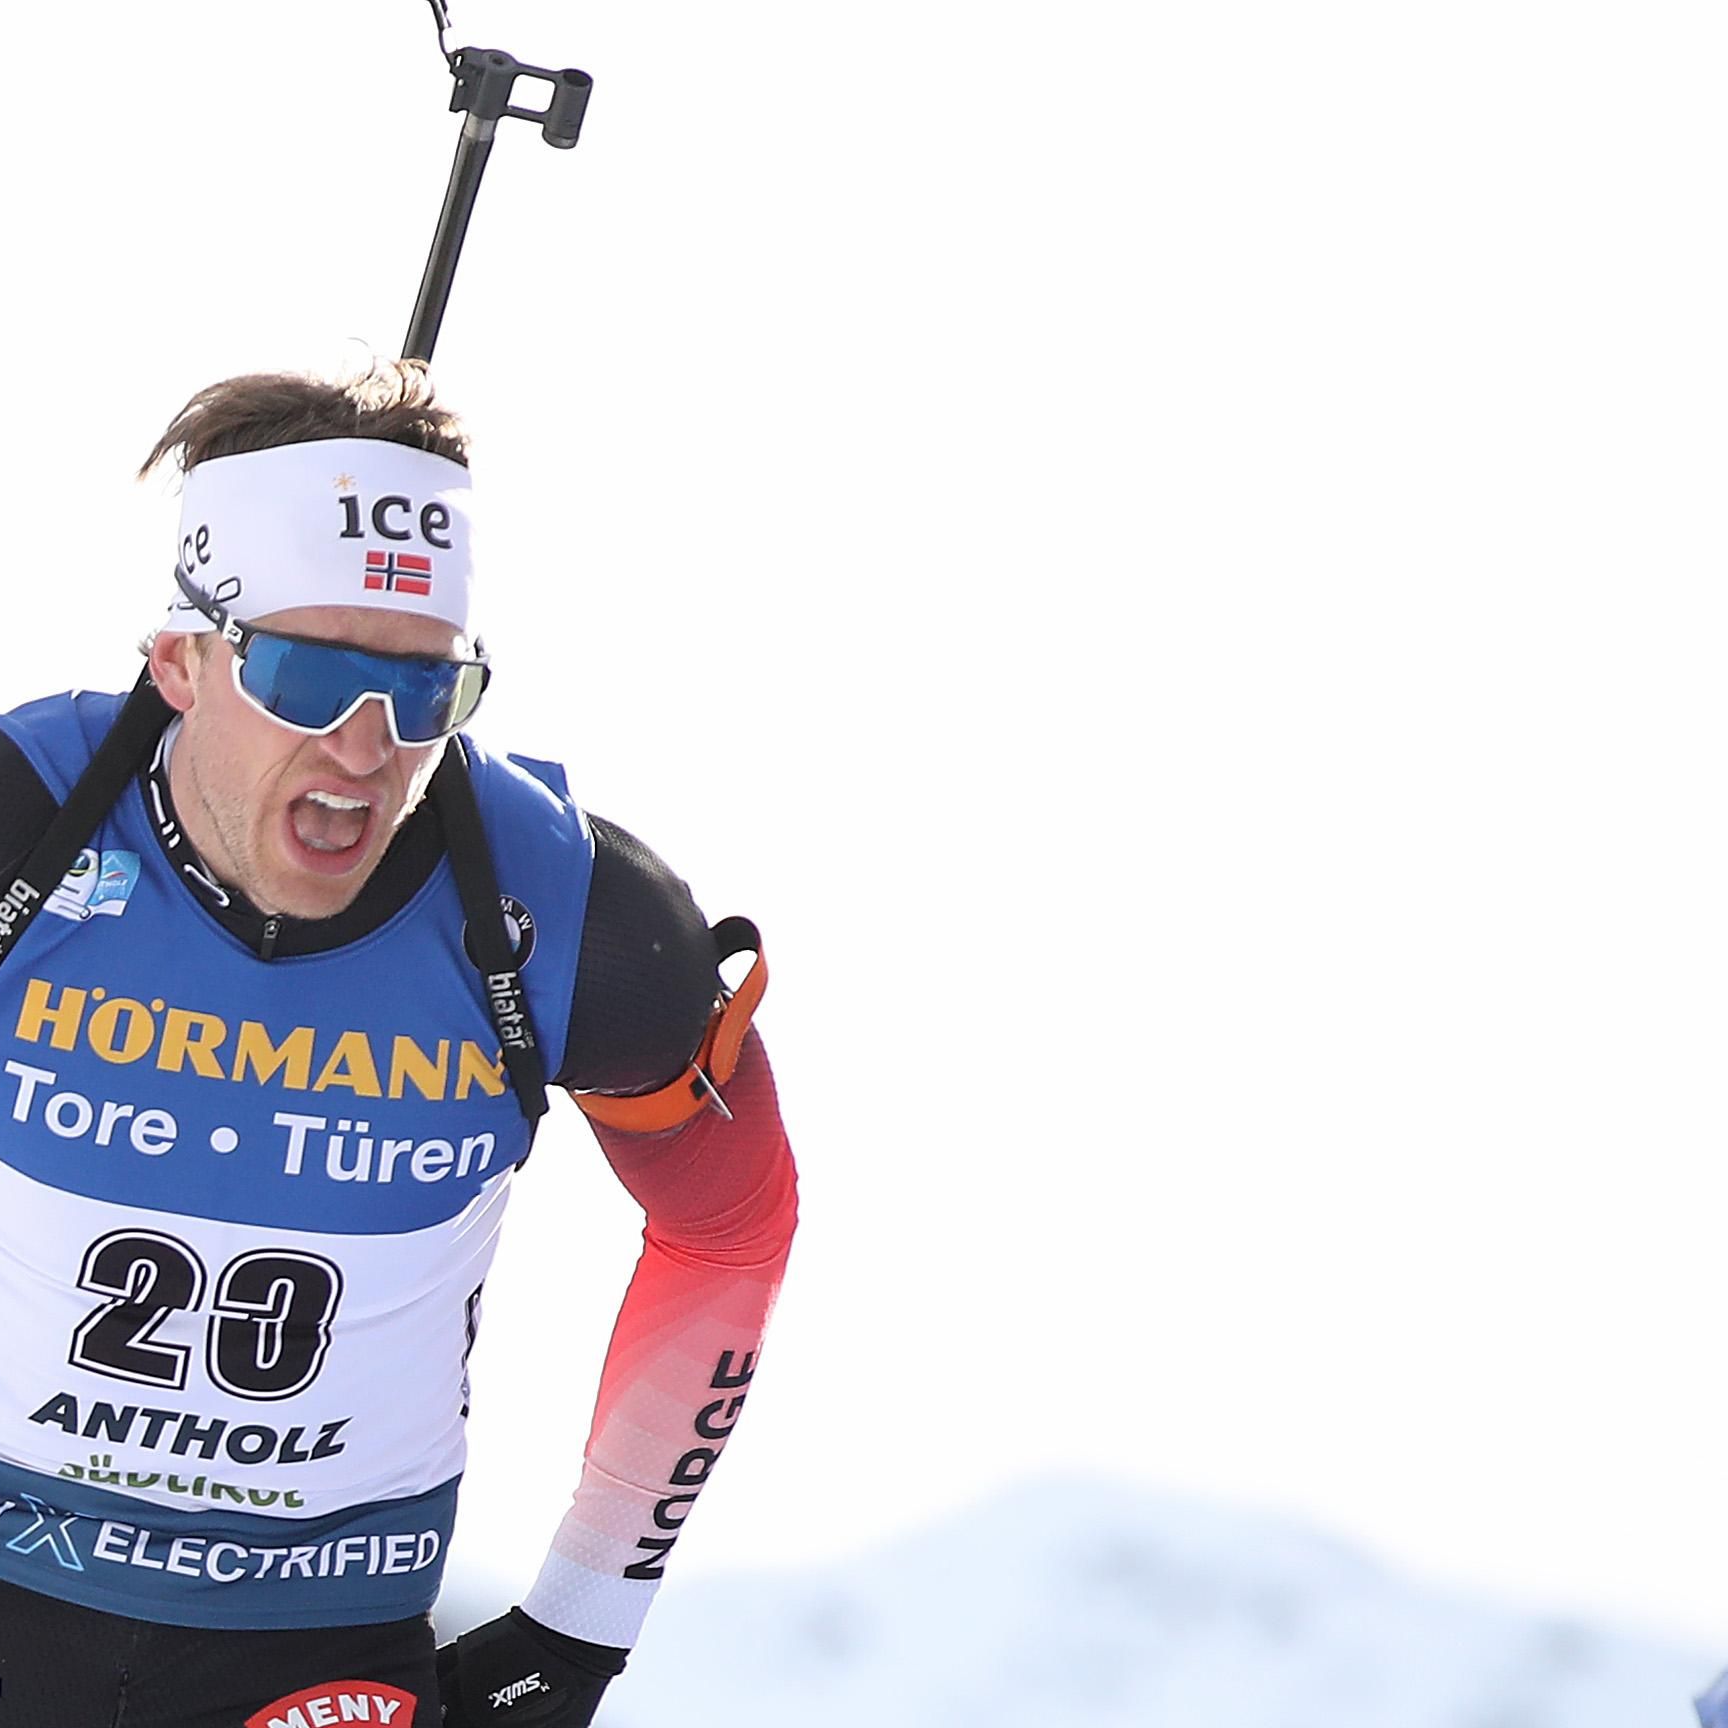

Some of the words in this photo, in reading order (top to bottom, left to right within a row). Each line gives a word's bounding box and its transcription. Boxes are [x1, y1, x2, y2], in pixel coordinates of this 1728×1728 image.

[183, 523, 212, 575] ce
[14, 977, 505, 1101] HÖRMANN
[3, 1060, 179, 1156] Tore
[272, 1111, 495, 1184] Türen
[68, 1227, 346, 1402] 23
[29, 1391, 354, 1466] ANTHOLZ
[623, 1350, 755, 1581] NORGE
[92, 1519, 439, 1583] ELECTRIFIED
